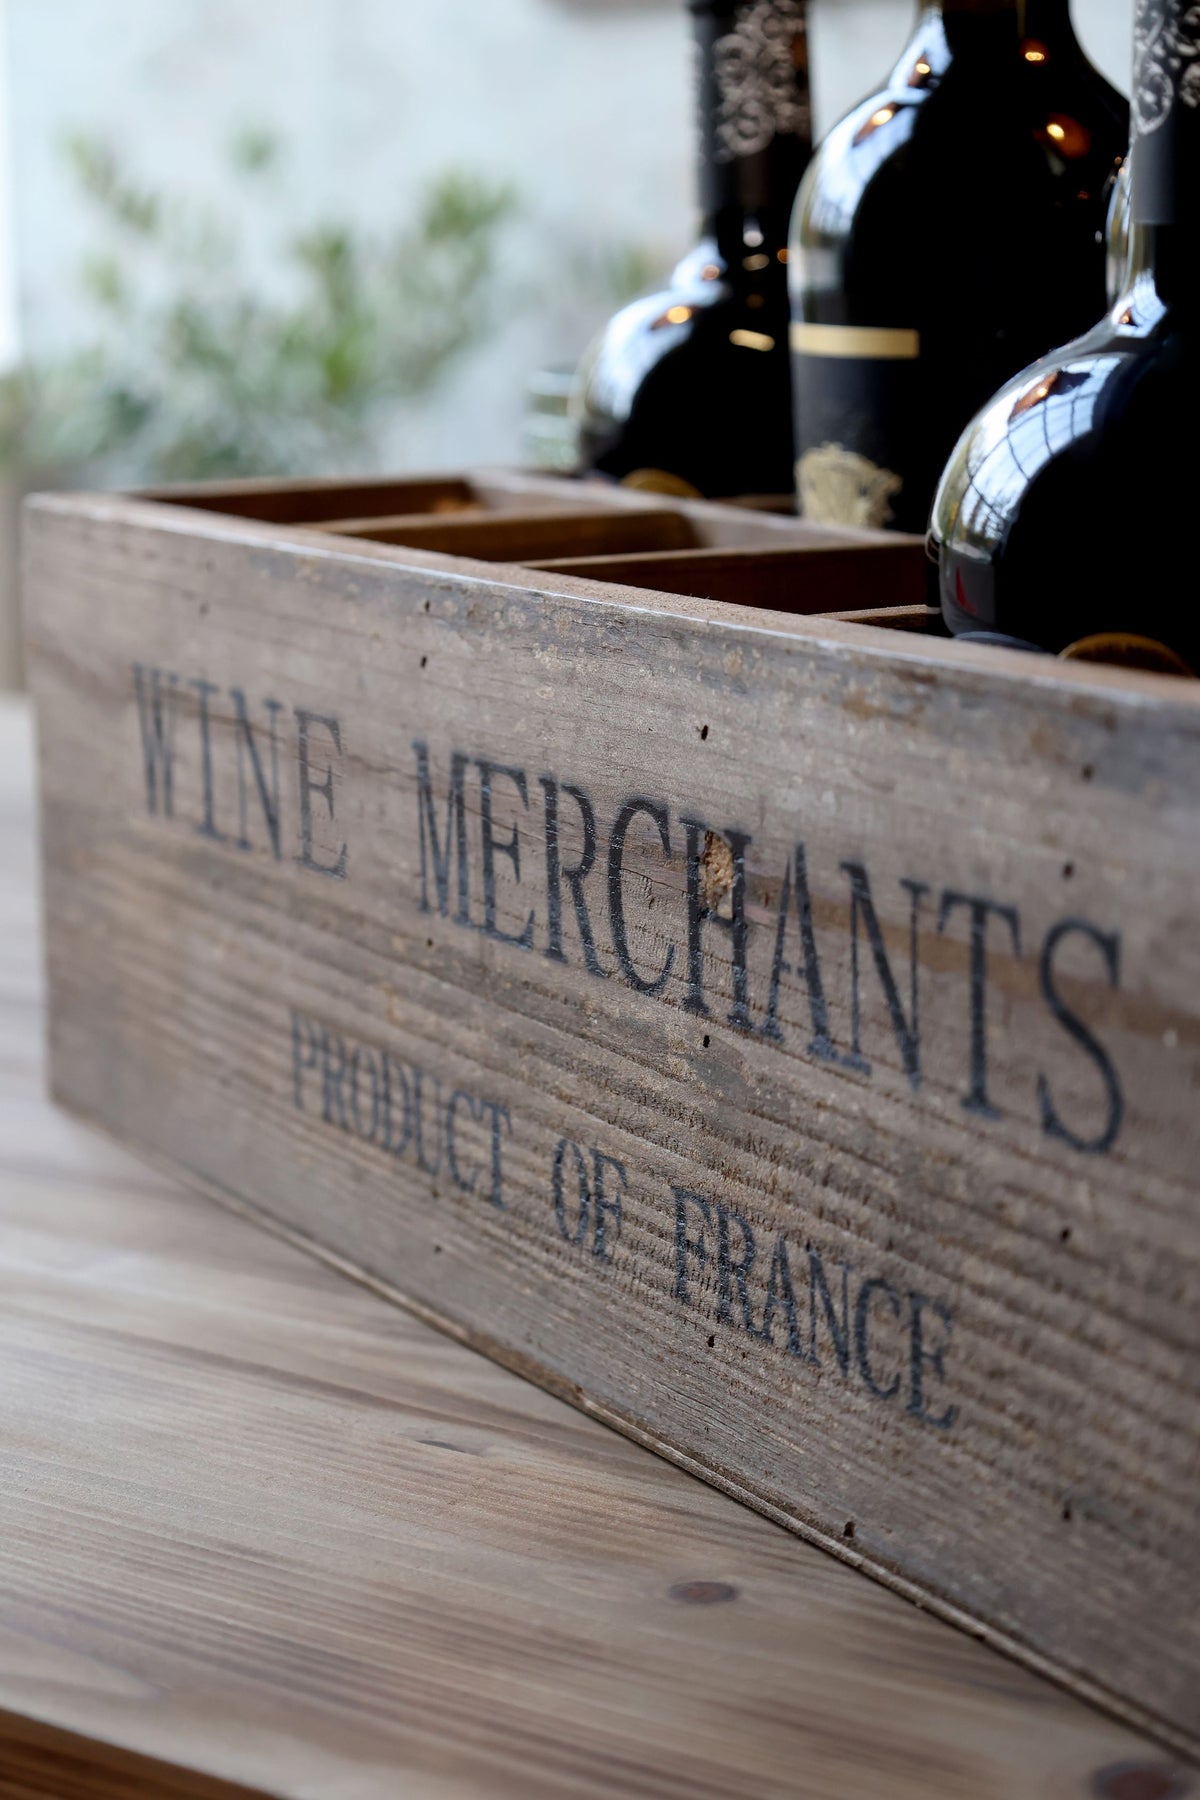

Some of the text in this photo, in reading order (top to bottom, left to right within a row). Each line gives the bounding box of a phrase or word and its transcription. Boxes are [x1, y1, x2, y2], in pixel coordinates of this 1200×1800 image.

[131, 662, 1124, 1154] WINE MERCHANTS
[289, 1007, 957, 1430] PRODUCT OF FRANCE
